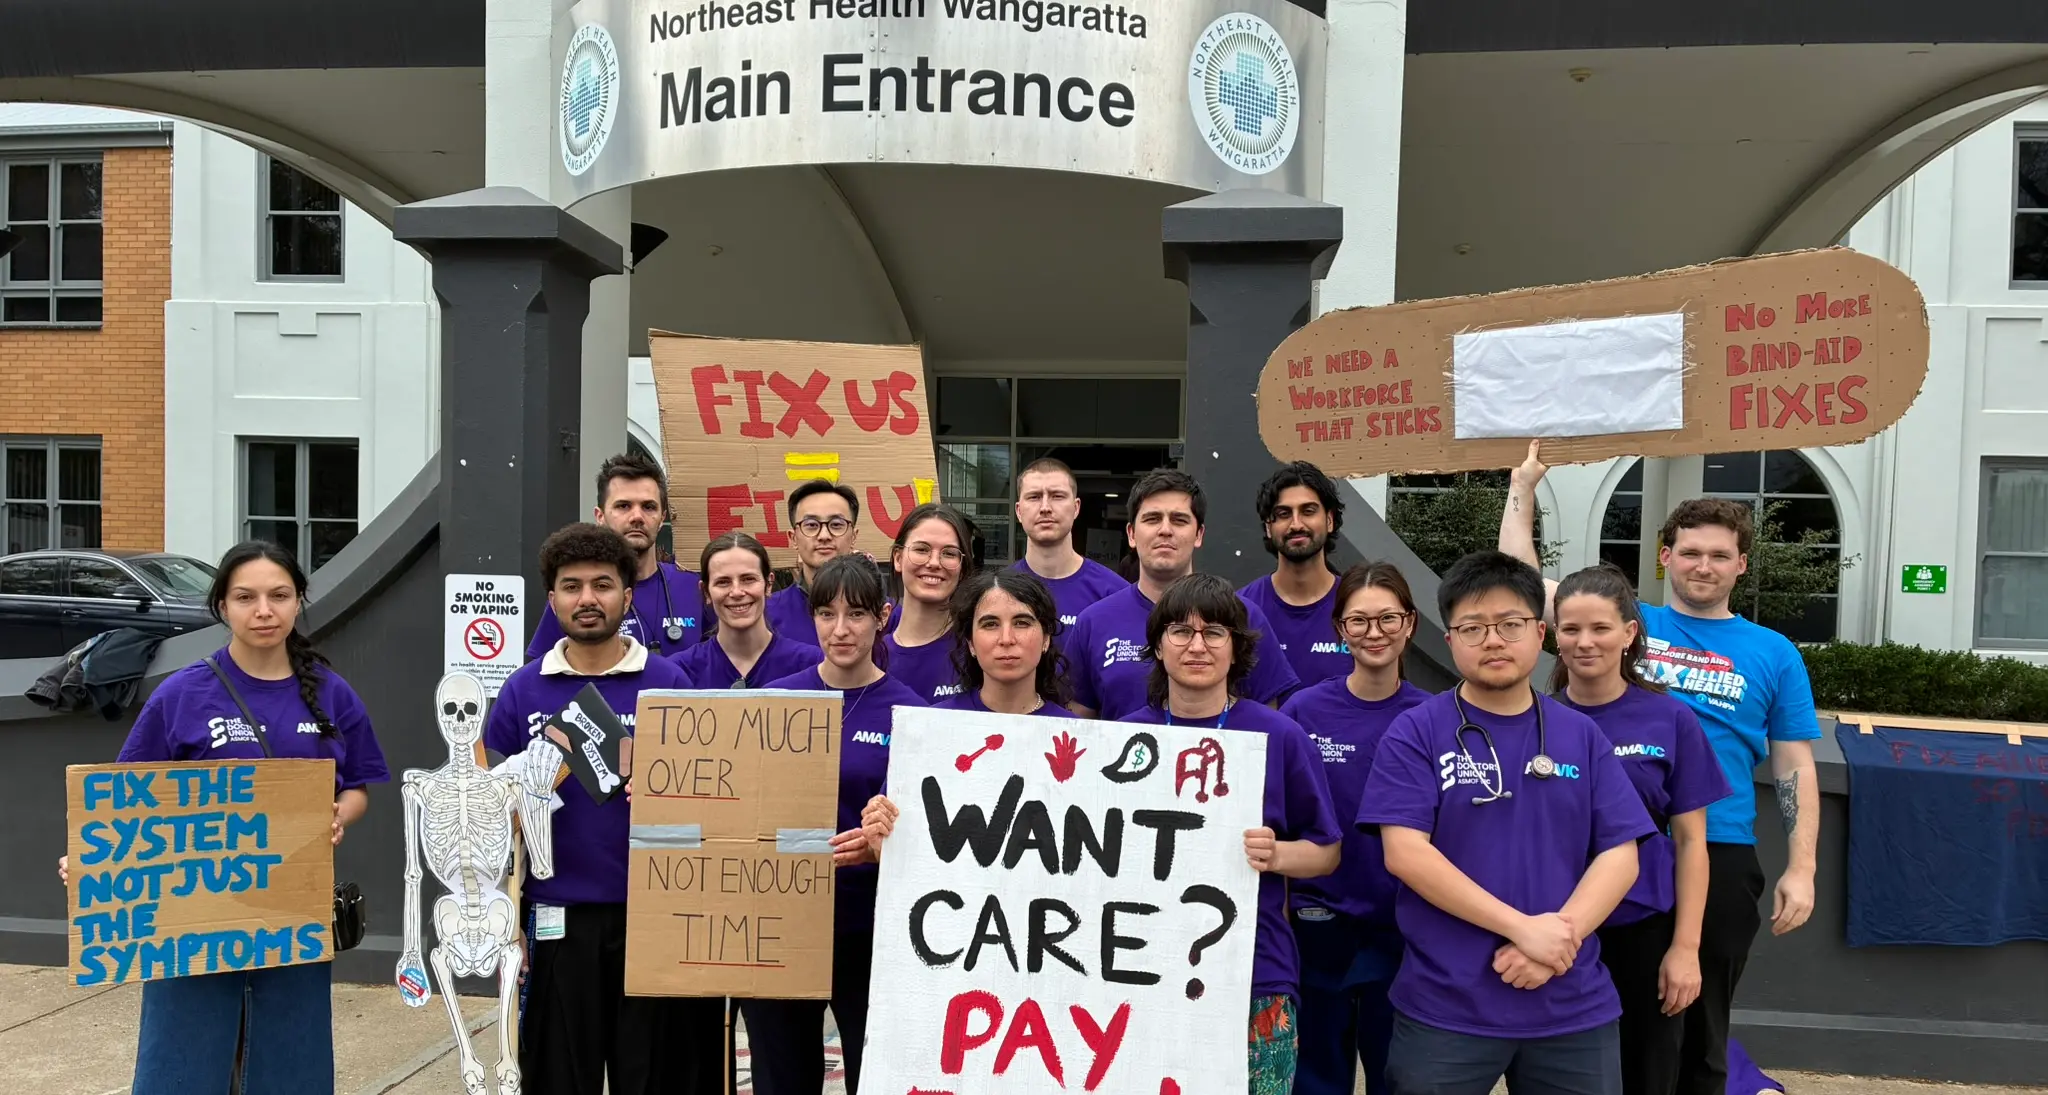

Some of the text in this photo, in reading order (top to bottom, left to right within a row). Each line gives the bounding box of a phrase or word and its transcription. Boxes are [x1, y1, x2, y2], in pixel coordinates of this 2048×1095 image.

[650, 0, 1148, 43] Northeast Health Wangaratta
[593, 27, 617, 82] HEALTH
[1193, 18, 1297, 106] NORTHEAST HEALTH
[659, 53, 1136, 129] Main Entrance
[564, 130, 607, 171] WANGARATTA
[1208, 128, 1286, 170] WANGARATTA
[1287, 349, 1399, 379] WE NEED A
[1725, 335, 1863, 377] BAND-AID
[691, 364, 920, 440] FIX US
[1289, 379, 1414, 411] WORKFORCE
[1728, 375, 1869, 430] FIXES
[1296, 405, 1443, 443] THAT STICKS
[706, 483, 790, 549] FI
[455, 593, 515, 603] SMOKING
[475, 582, 494, 591] NO
[450, 604, 519, 615] OR VAPING
[1648, 648, 1661, 656] NO
[1661, 649, 1686, 659] MORE
[1686, 653, 1710, 664] BAND
[1683, 678, 1743, 700] HEALTH
[1686, 668, 1745, 687] ALLIED
[225, 717, 241, 725] THE
[1708, 697, 1736, 712] VAHPA
[574, 712, 604, 741] BROKEN
[647, 705, 830, 754] TOO MUCH
[584, 742, 609, 780] SYSTEM
[1614, 743, 1666, 758] AMAVIC
[83, 765, 256, 811] FIX THE
[647, 758, 734, 797] OVER
[79, 811, 268, 866] SYSTEM
[920, 771, 1206, 882] WANT
[78, 854, 282, 909] NOT JUST
[648, 855, 831, 895] NOT ENOUGH
[73, 902, 159, 946] THE
[672, 913, 783, 963] TIME
[908, 883, 1239, 1000] CARE?
[76, 922, 326, 987] SYMPTOMS
[939, 988, 1133, 1092] PAY
